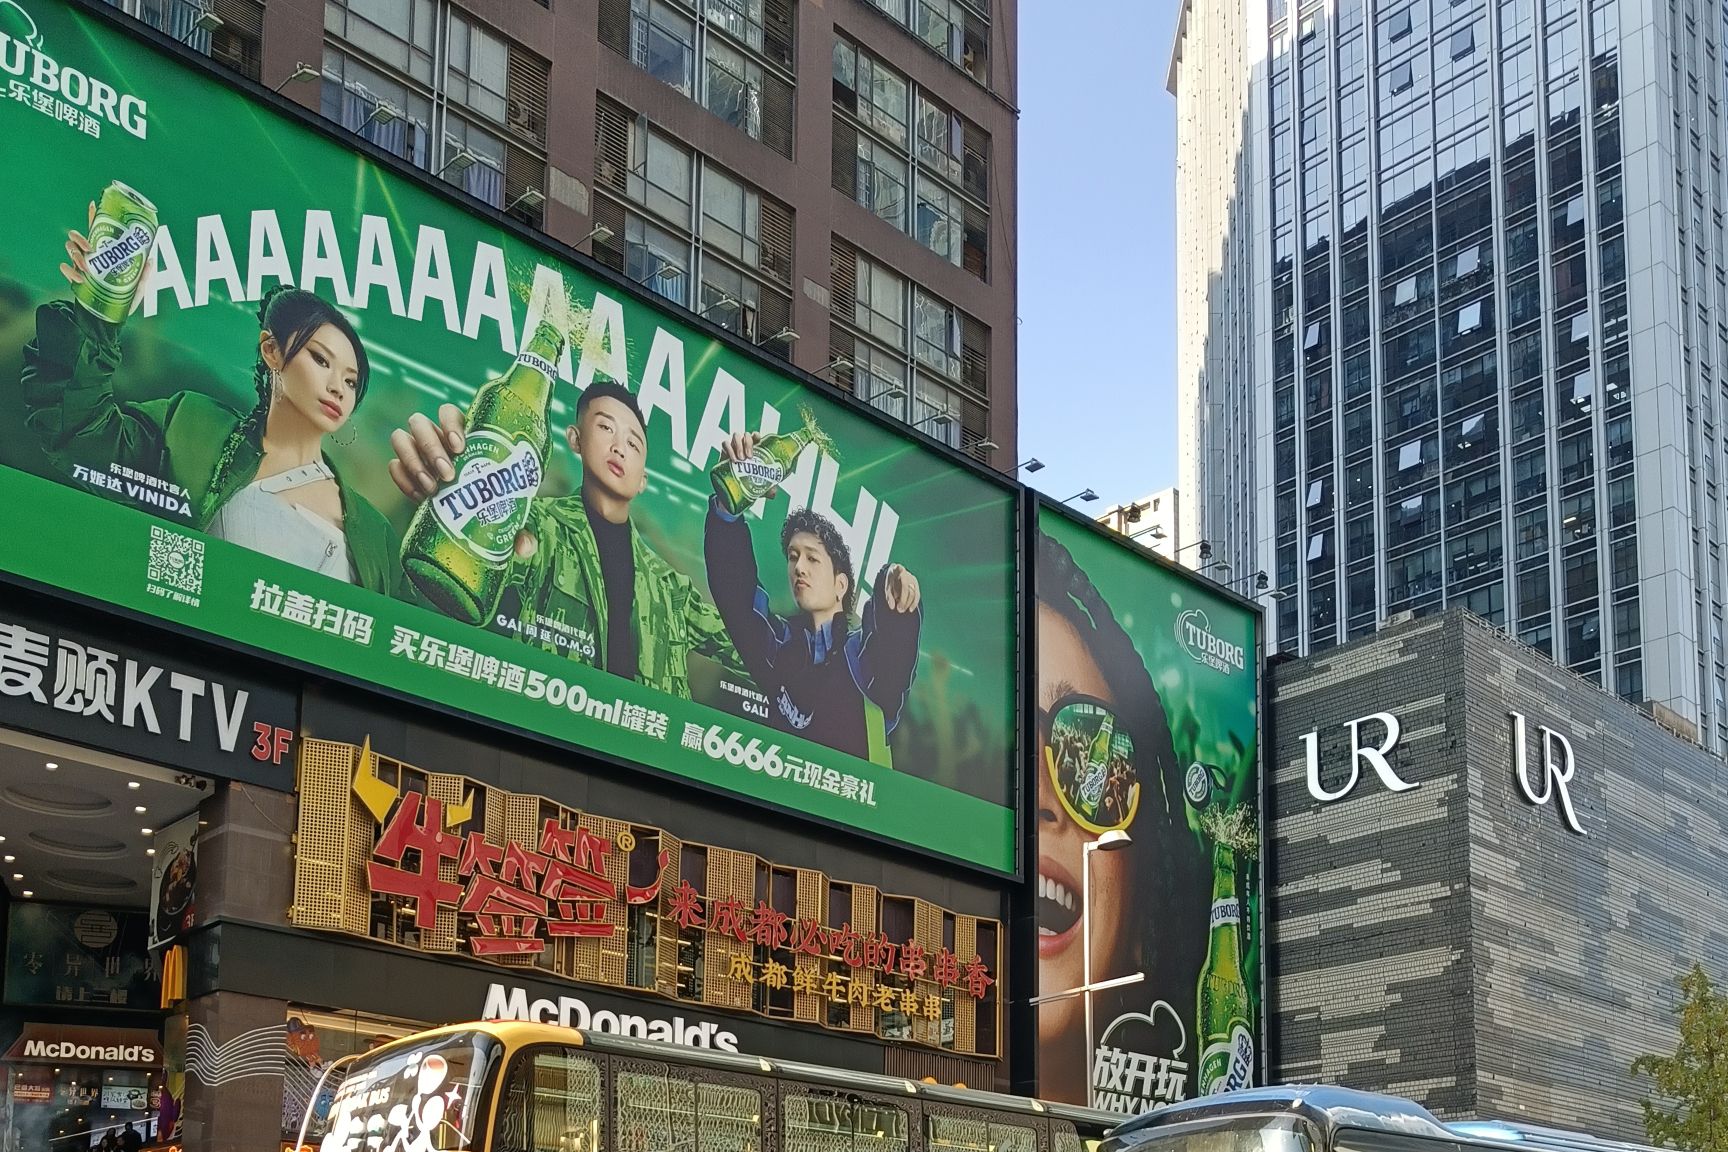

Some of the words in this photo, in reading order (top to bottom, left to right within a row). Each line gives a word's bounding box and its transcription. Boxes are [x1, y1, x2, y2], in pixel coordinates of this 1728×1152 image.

[0, 31, 147, 140] UBORG
[9, 79, 101, 139] 乐堡啤酒
[88, 235, 140, 275] TUBORG
[73, 463, 123, 493] 万妮达
[126, 482, 192, 518] VINIDA
[110, 462, 191, 500] 乐堡啤酒代言人
[440, 462, 528, 521] TUBORG
[734, 461, 775, 480] TUBORG
[476, 498, 517, 527] 乐堡啤酒
[496, 614, 522, 633] GAI
[554, 633, 596, 658] (D.M.G)
[1186, 621, 1244, 670] TUBORG
[249, 578, 375, 646] 拉盖扫码
[389, 624, 670, 743] 买乐堡啤酒500ml罐装
[681, 721, 878, 807] 赢6666元现金豪礼
[742, 700, 769, 718] GALI
[250, 721, 294, 766] 3F
[1299, 711, 1420, 801] UR
[1509, 710, 1588, 836] UR
[666, 879, 996, 1001] 来成都必吃的串串香
[726, 951, 943, 1022] 成都鲜牛肉老串串
[481, 982, 740, 1054] McDonald's
[23, 1039, 155, 1063] McDonald's
[1093, 1045, 1189, 1101] 放开玩
